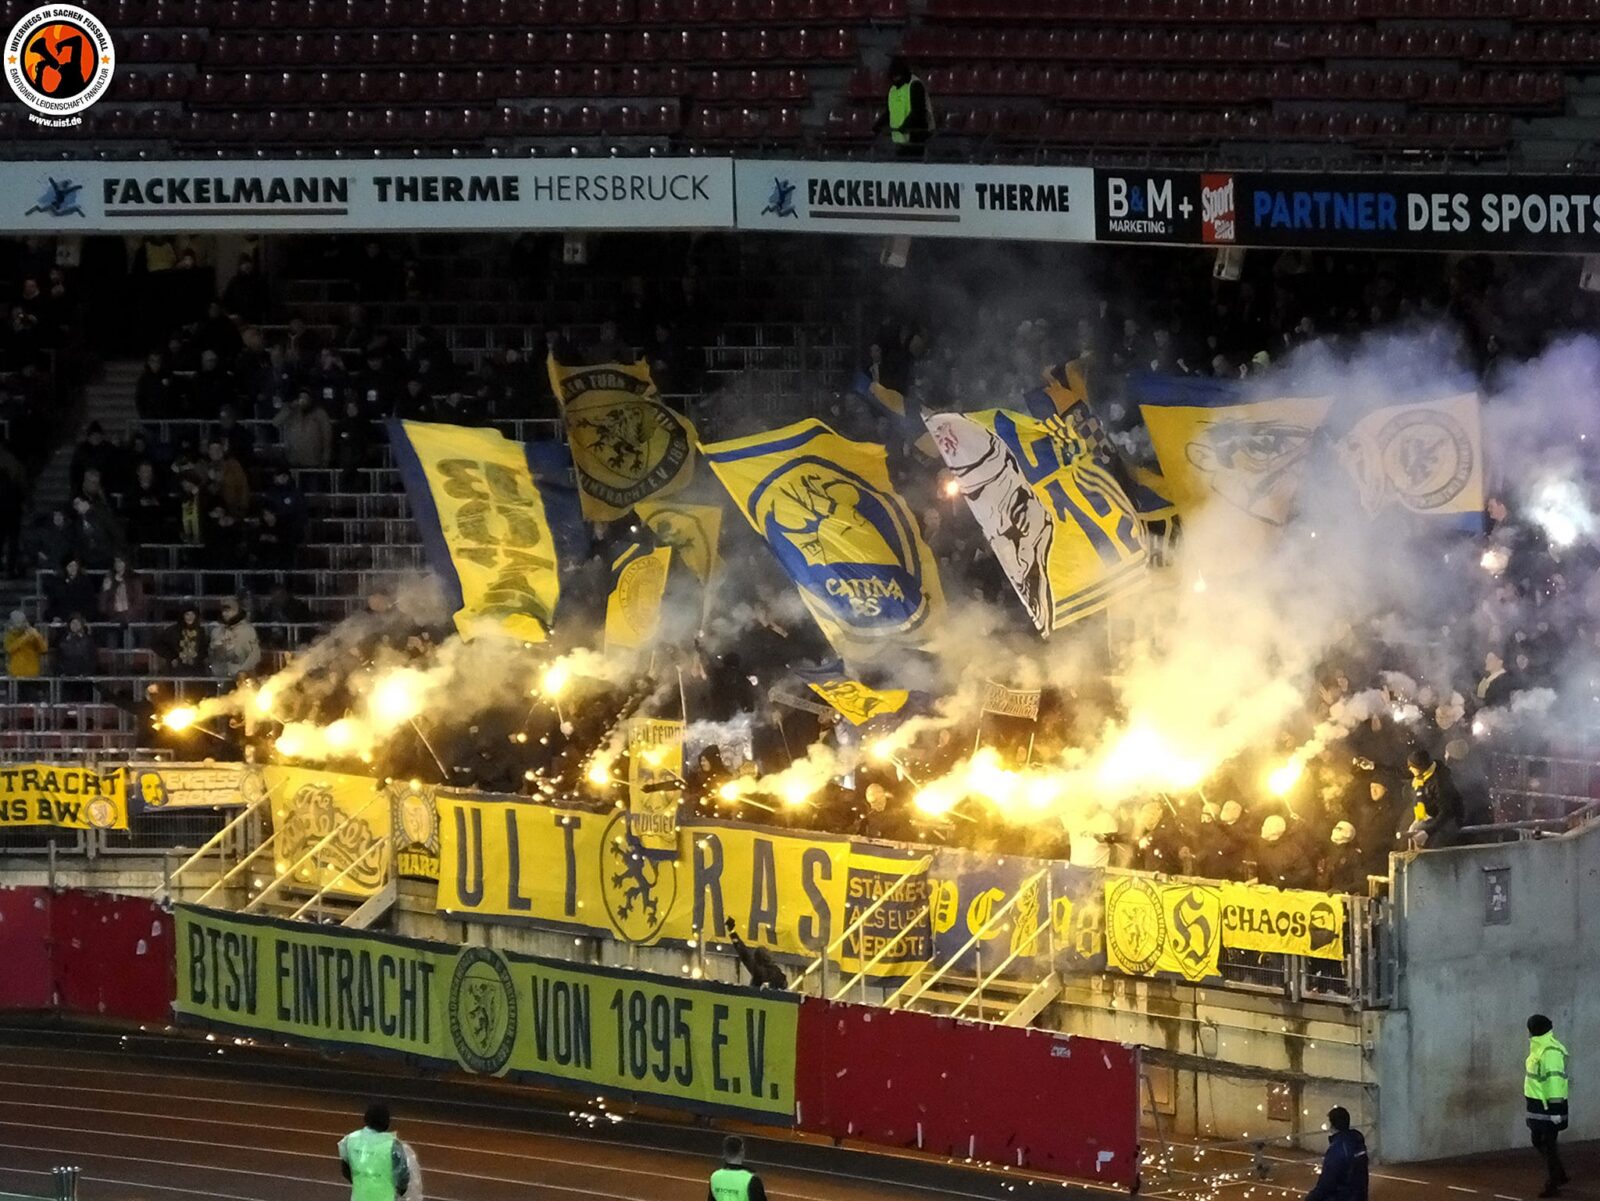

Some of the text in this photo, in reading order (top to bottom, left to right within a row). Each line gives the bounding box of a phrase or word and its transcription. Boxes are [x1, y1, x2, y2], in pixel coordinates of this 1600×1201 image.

[103, 174, 709, 204] FACKELMANN THERME HERSBRUCK
[808, 178, 1069, 212] FACKELMANN THERME
[1107, 177, 1173, 219] B&M
[1202, 178, 1234, 224] Sport
[1109, 220, 1166, 234] MARKETING
[1253, 190, 1397, 232] PARTNER
[1407, 192, 1470, 232] DES
[0, 769, 120, 796] TRACHT
[37, 798, 81, 823] BW
[454, 806, 833, 952] ULTRAS
[1223, 904, 1306, 937] CHAOS
[188, 921, 258, 1015] BTSV
[274, 938, 434, 1044] EINTRACHT
[531, 975, 592, 1070] VON
[610, 985, 694, 1087] 1895
[712, 1003, 780, 1100] E.V.
